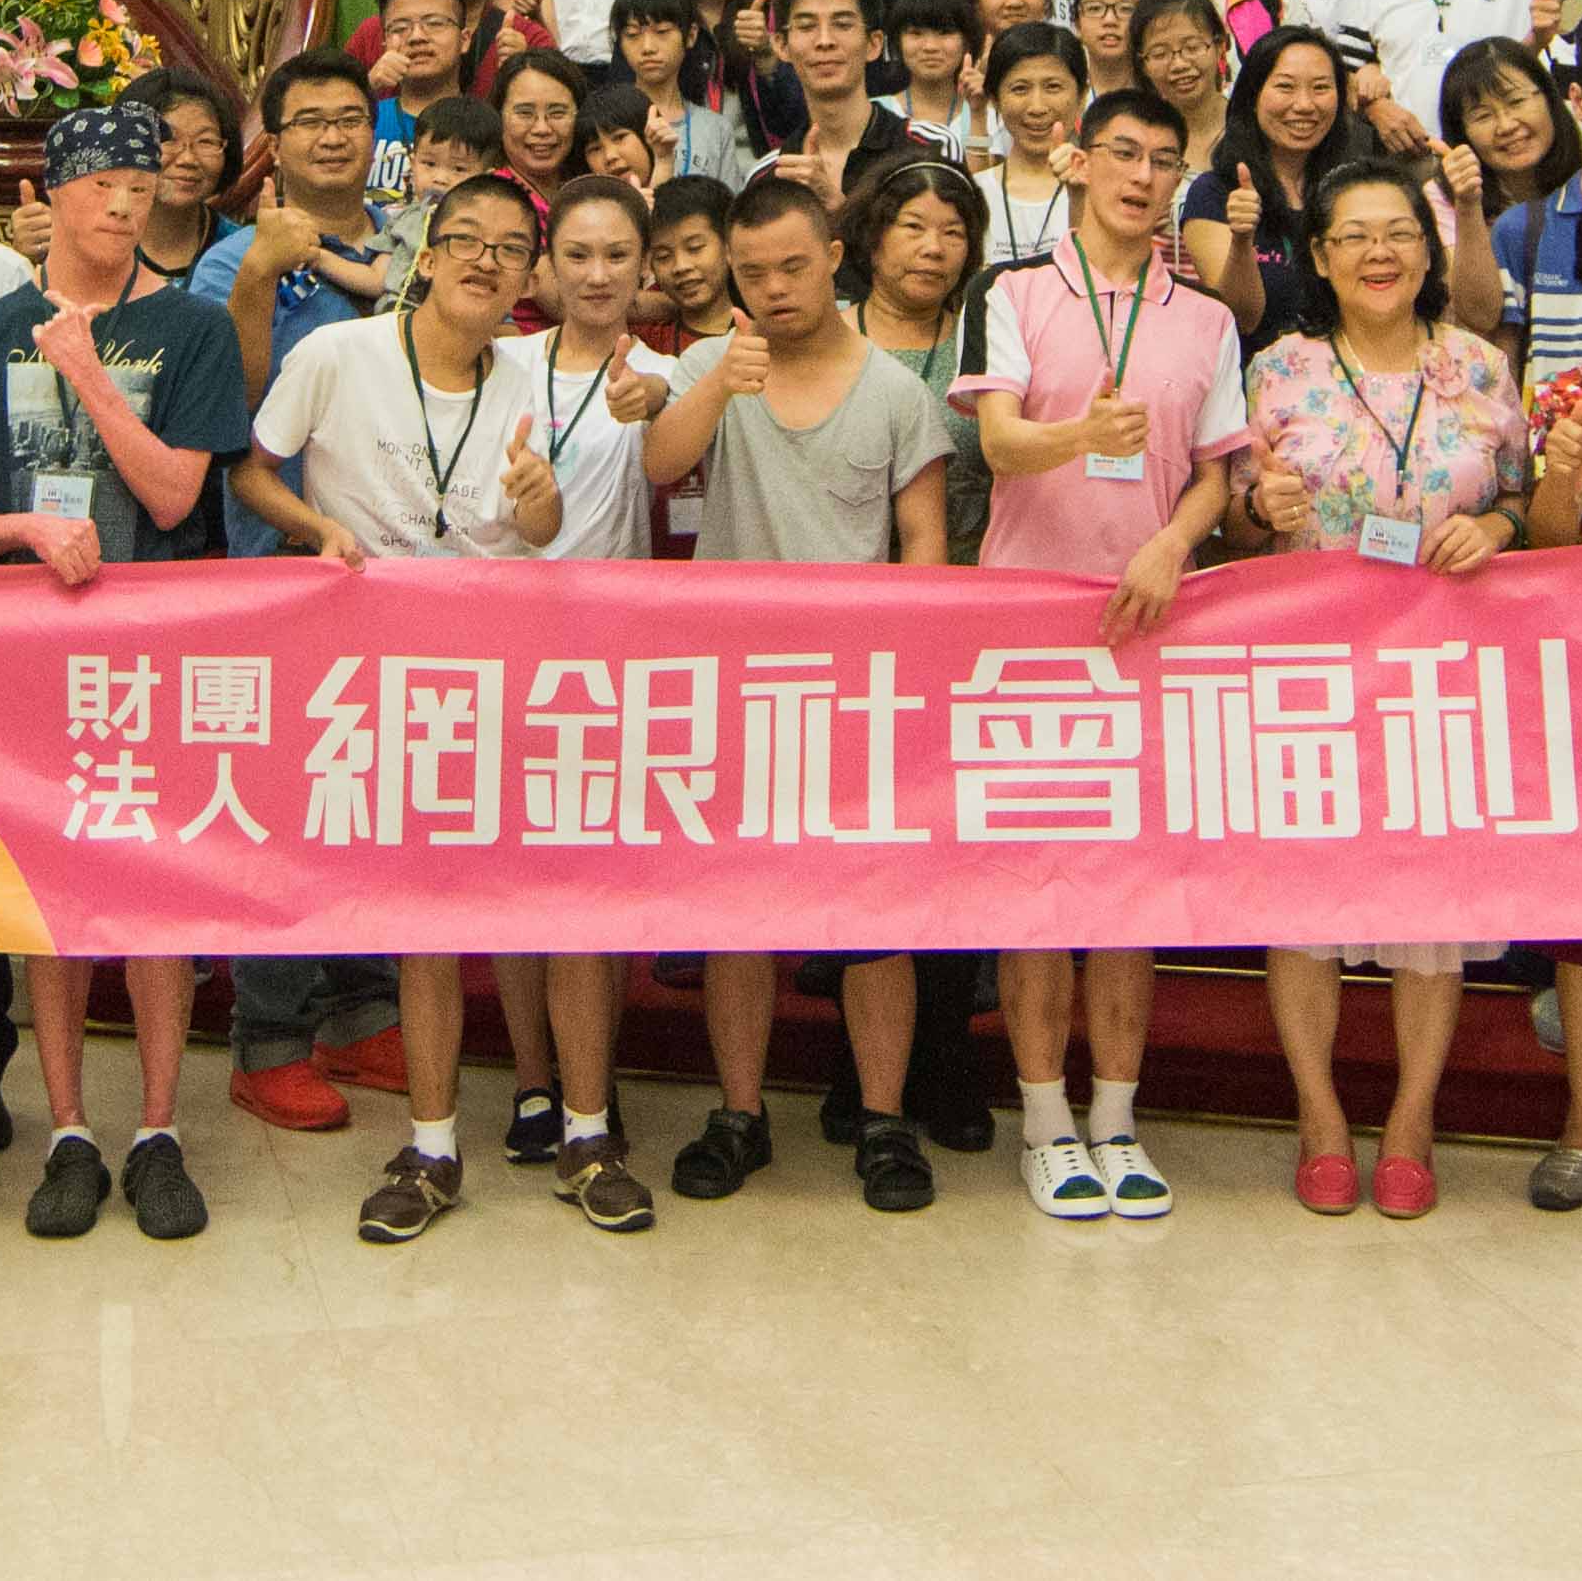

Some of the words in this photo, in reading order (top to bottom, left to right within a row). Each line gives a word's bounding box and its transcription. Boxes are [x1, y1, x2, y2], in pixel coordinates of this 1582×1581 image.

[101, 339, 165, 376] York
[66, 654, 273, 745] 財團
[62, 751, 272, 845] 法人
